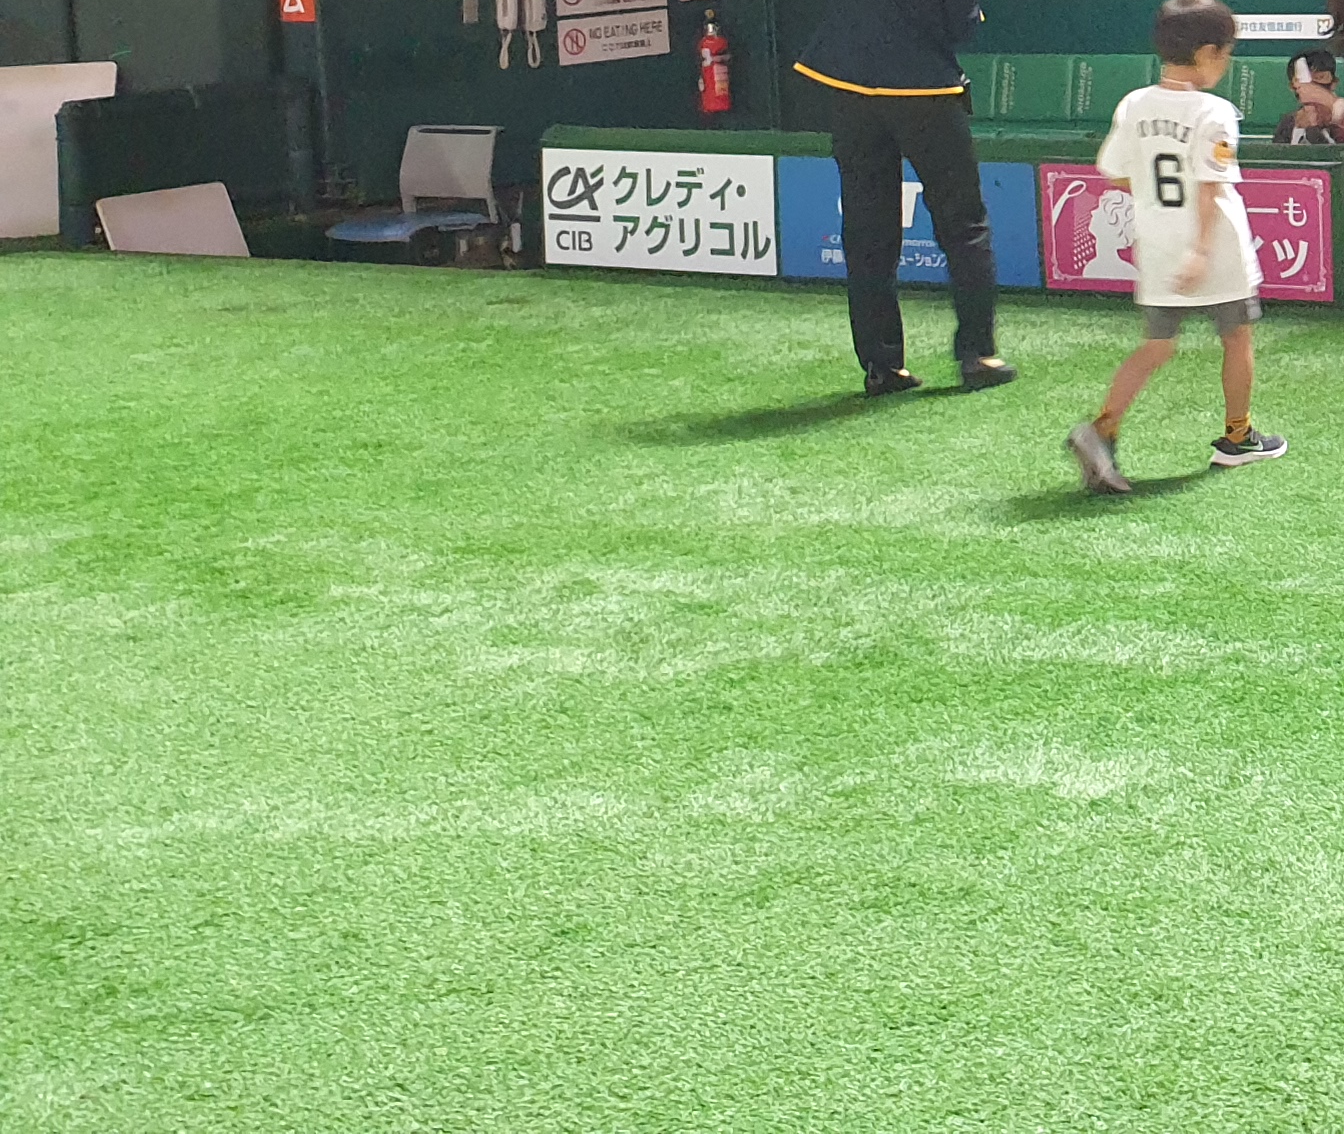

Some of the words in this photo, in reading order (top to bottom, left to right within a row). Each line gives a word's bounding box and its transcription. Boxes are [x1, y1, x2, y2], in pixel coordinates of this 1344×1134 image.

[639, 20, 663, 34] HERE
[1154, 153, 1184, 207] 6
[556, 230, 593, 251] CIB
[613, 214, 771, 260] アグリコル
